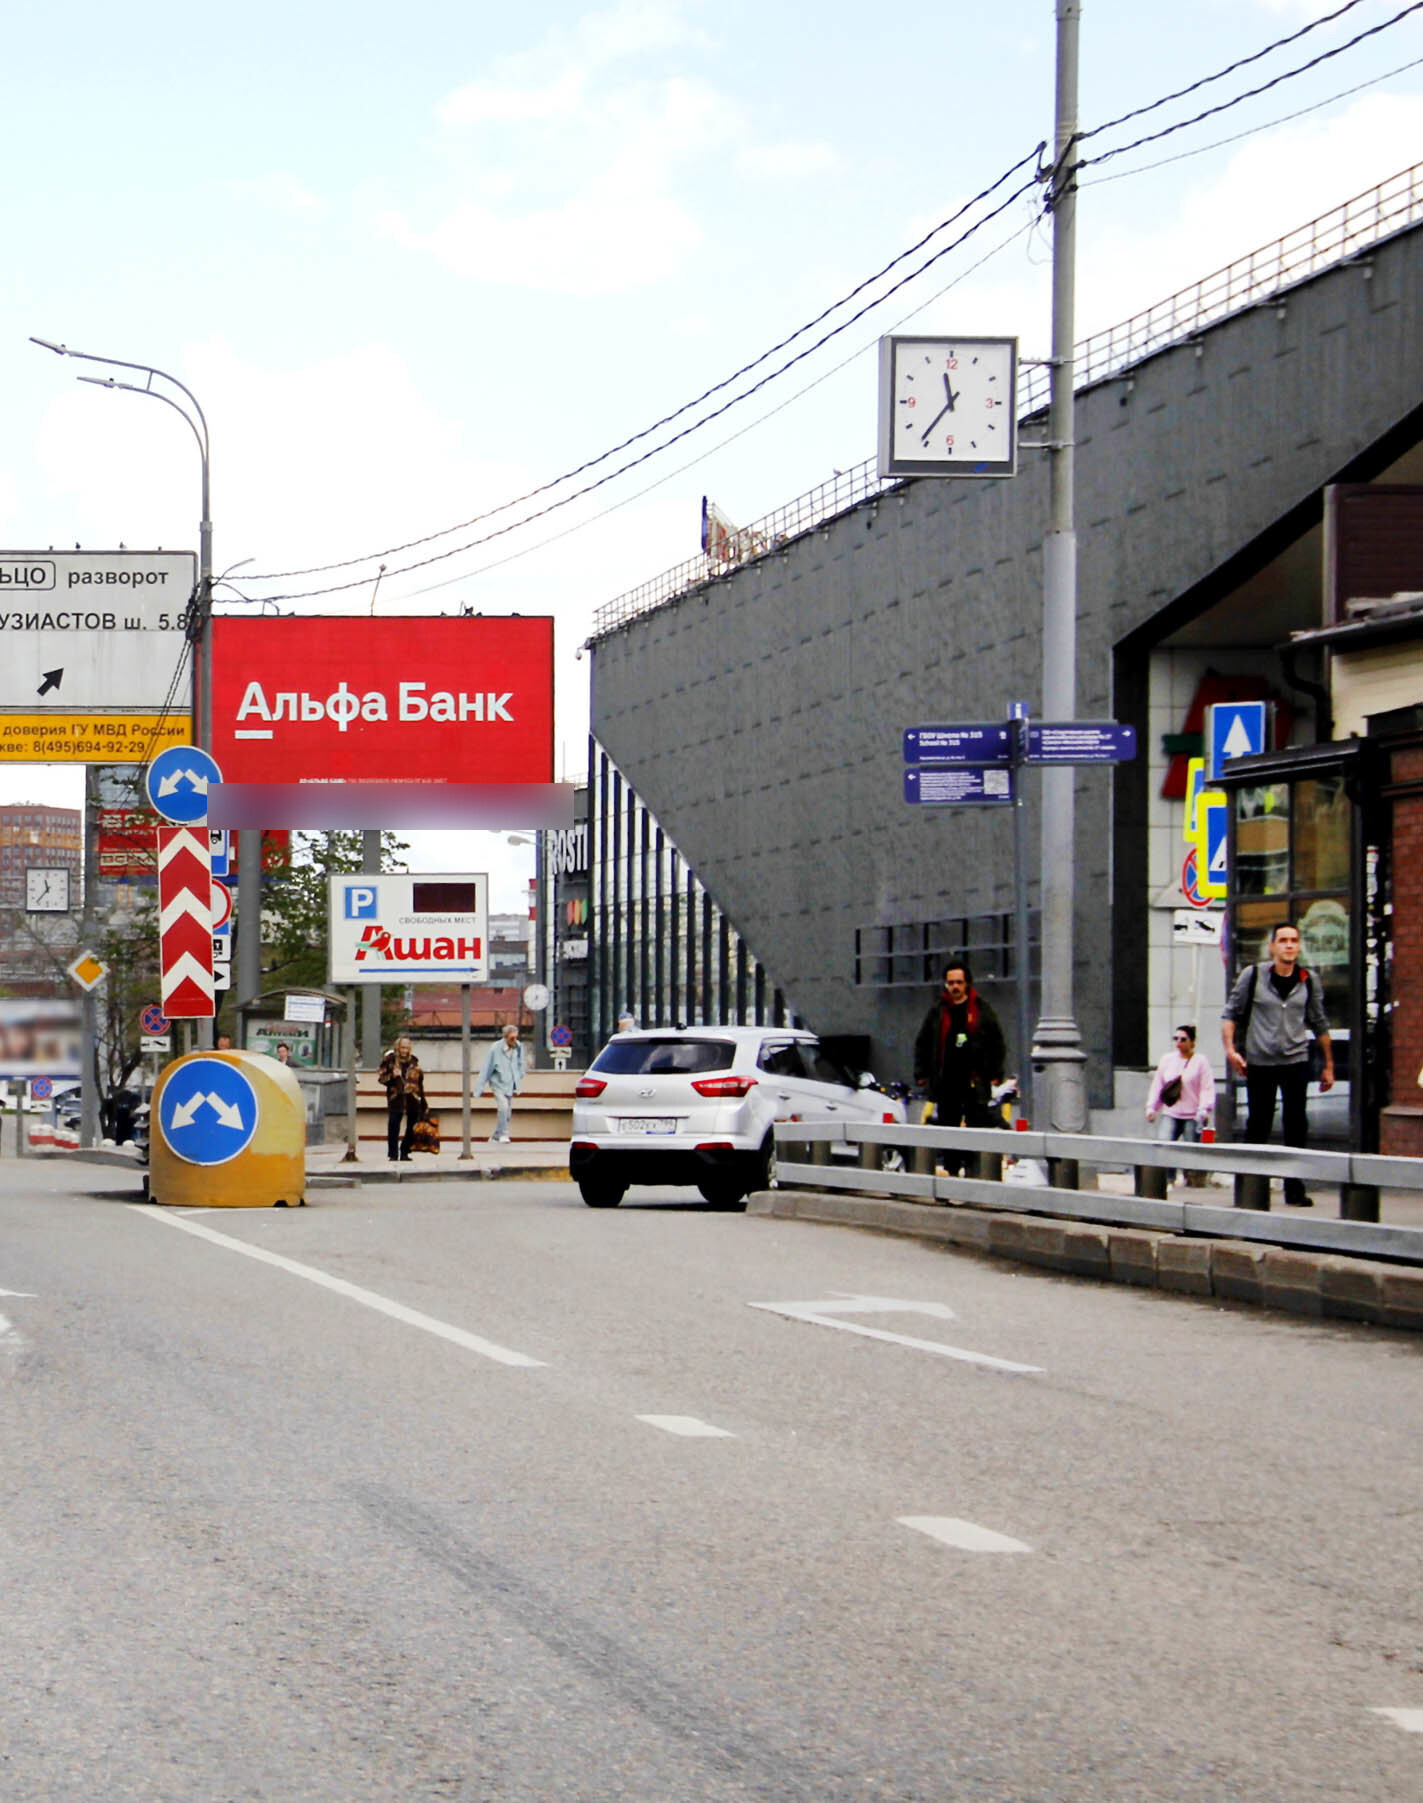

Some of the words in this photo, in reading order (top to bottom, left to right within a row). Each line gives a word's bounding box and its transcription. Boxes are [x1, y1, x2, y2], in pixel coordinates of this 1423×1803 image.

[945, 360, 958, 370] 12
[907, 397, 916, 408] 9
[985, 398, 994, 409] 3
[946, 435, 955, 446] 6
[67, 570, 169, 588] разворот
[124, 617, 147, 631] ш.
[158, 613, 188, 631] 5.8
[235, 680, 388, 733] Альфа
[398, 681, 515, 723] Банк
[3, 725, 67, 737] доверия
[93, 724, 128, 737] МВД
[131, 724, 185, 736] России
[32, 740, 145, 755] 8(495)694-92-29
[354, 925, 482, 961] Ашан
